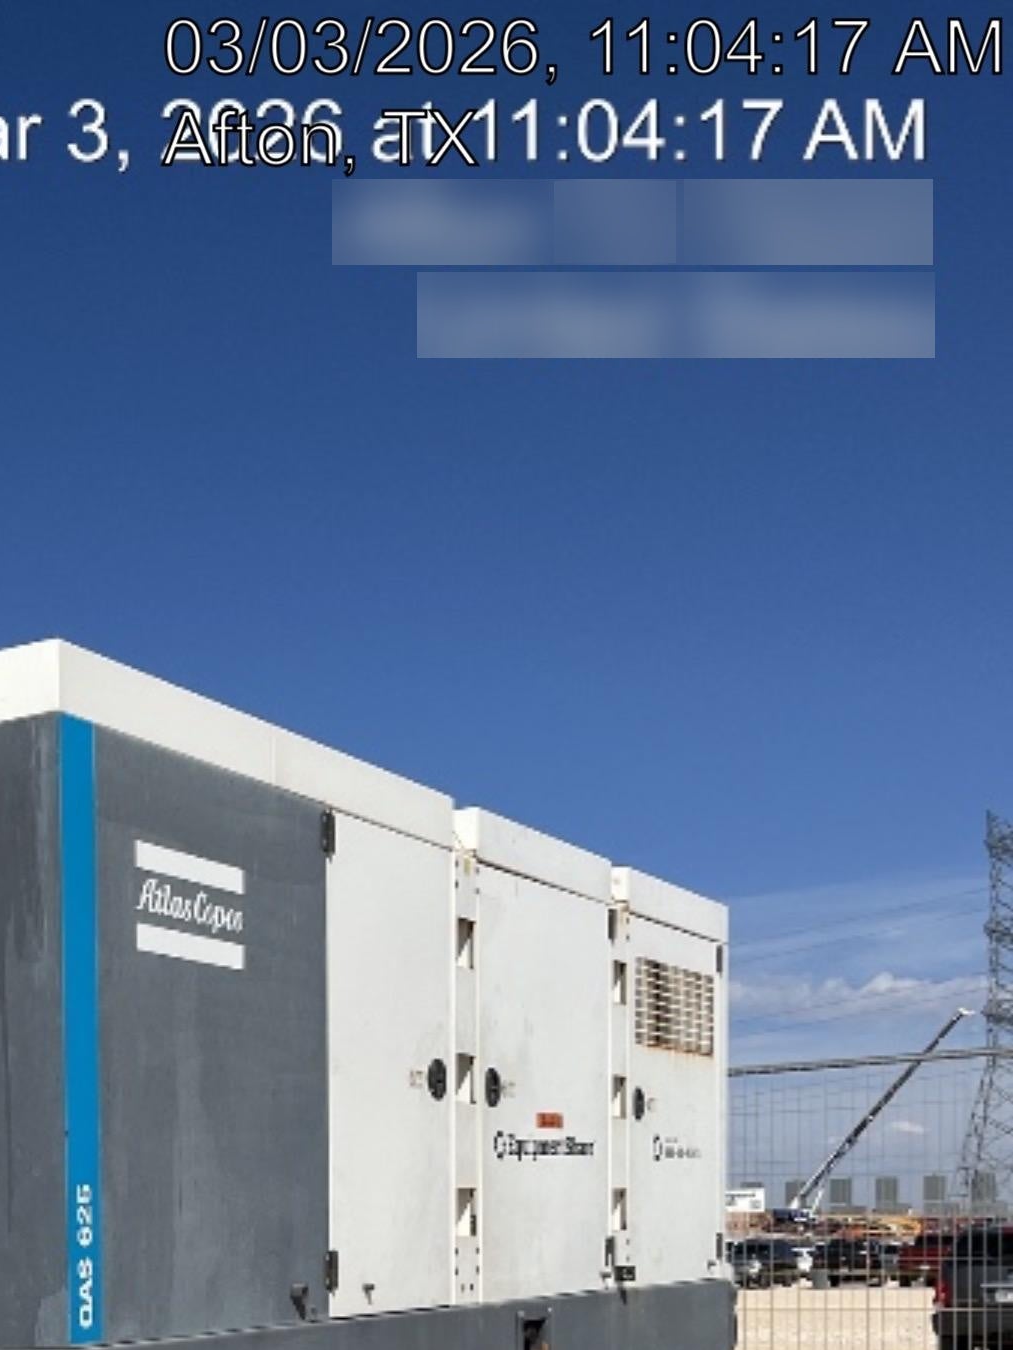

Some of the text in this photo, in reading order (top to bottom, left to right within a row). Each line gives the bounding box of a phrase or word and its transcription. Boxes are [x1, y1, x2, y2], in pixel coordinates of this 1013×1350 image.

[135, 878, 245, 934] Atlas Copco
[76, 1183, 94, 1247] 625
